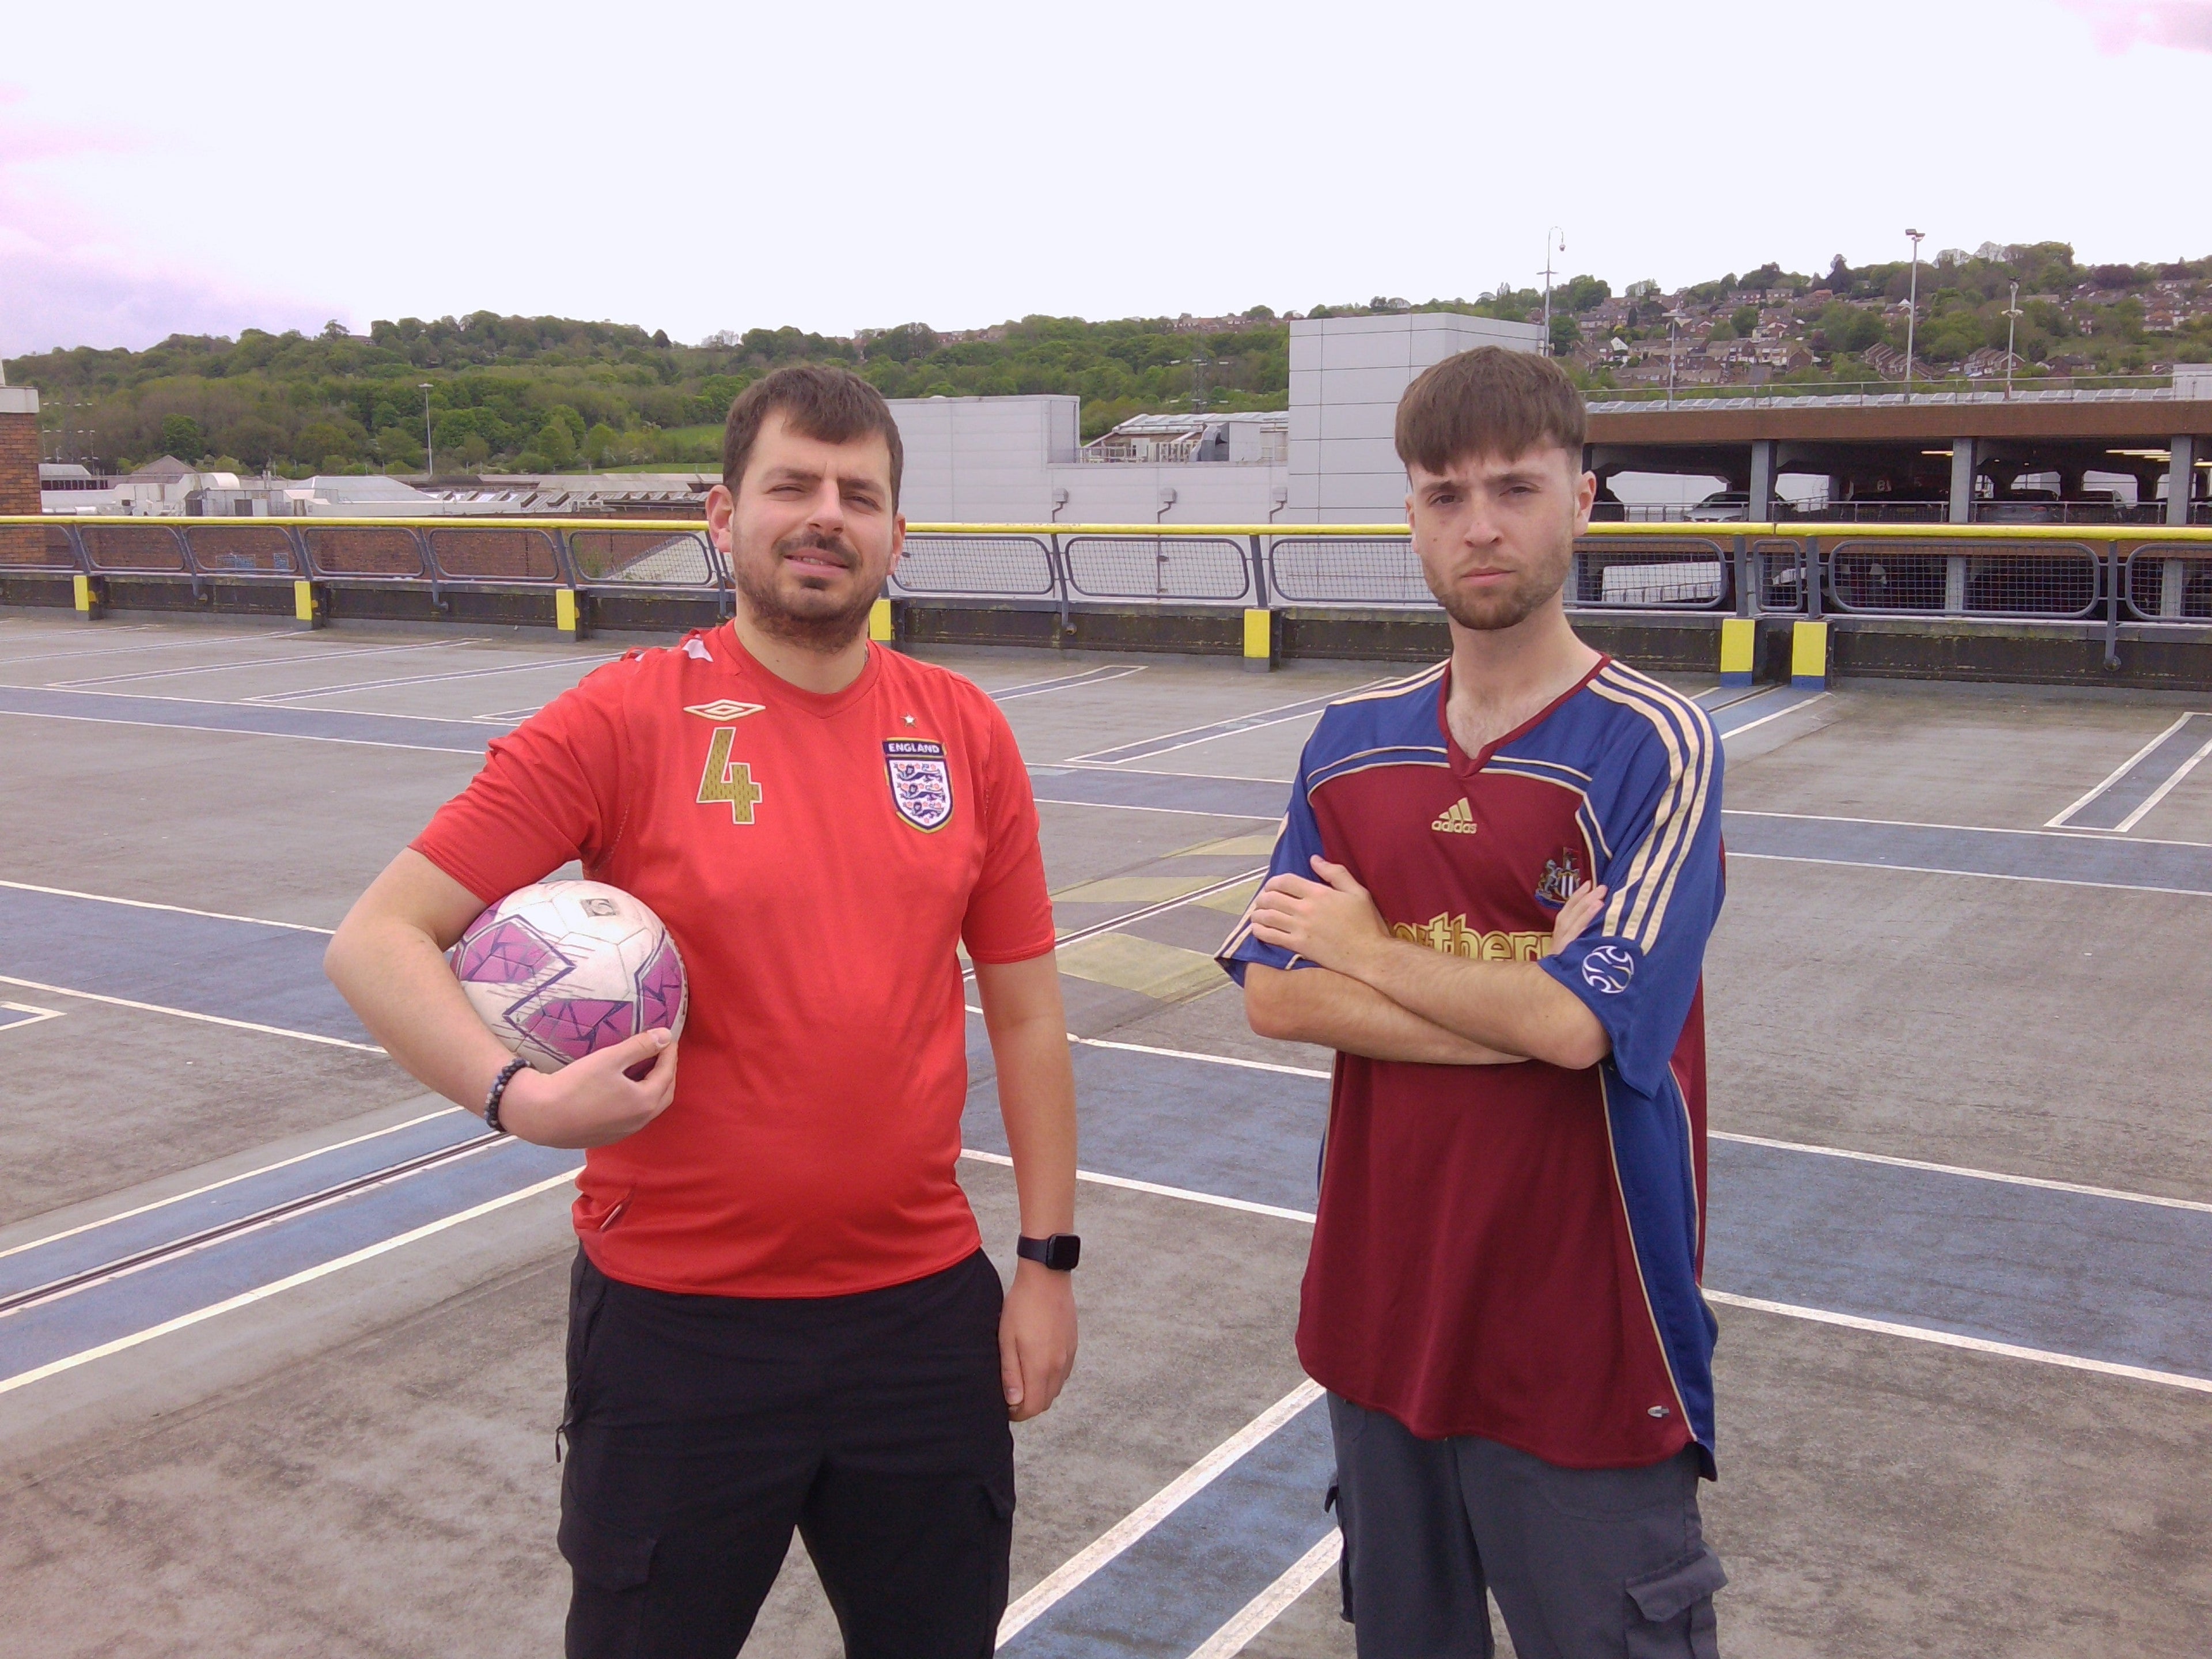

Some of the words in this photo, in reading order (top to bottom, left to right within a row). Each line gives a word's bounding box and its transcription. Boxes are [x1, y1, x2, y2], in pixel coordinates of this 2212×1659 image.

[888, 743, 940, 753] ENGLAND
[696, 727, 763, 824] 4
[1431, 819, 1478, 834] adidas
